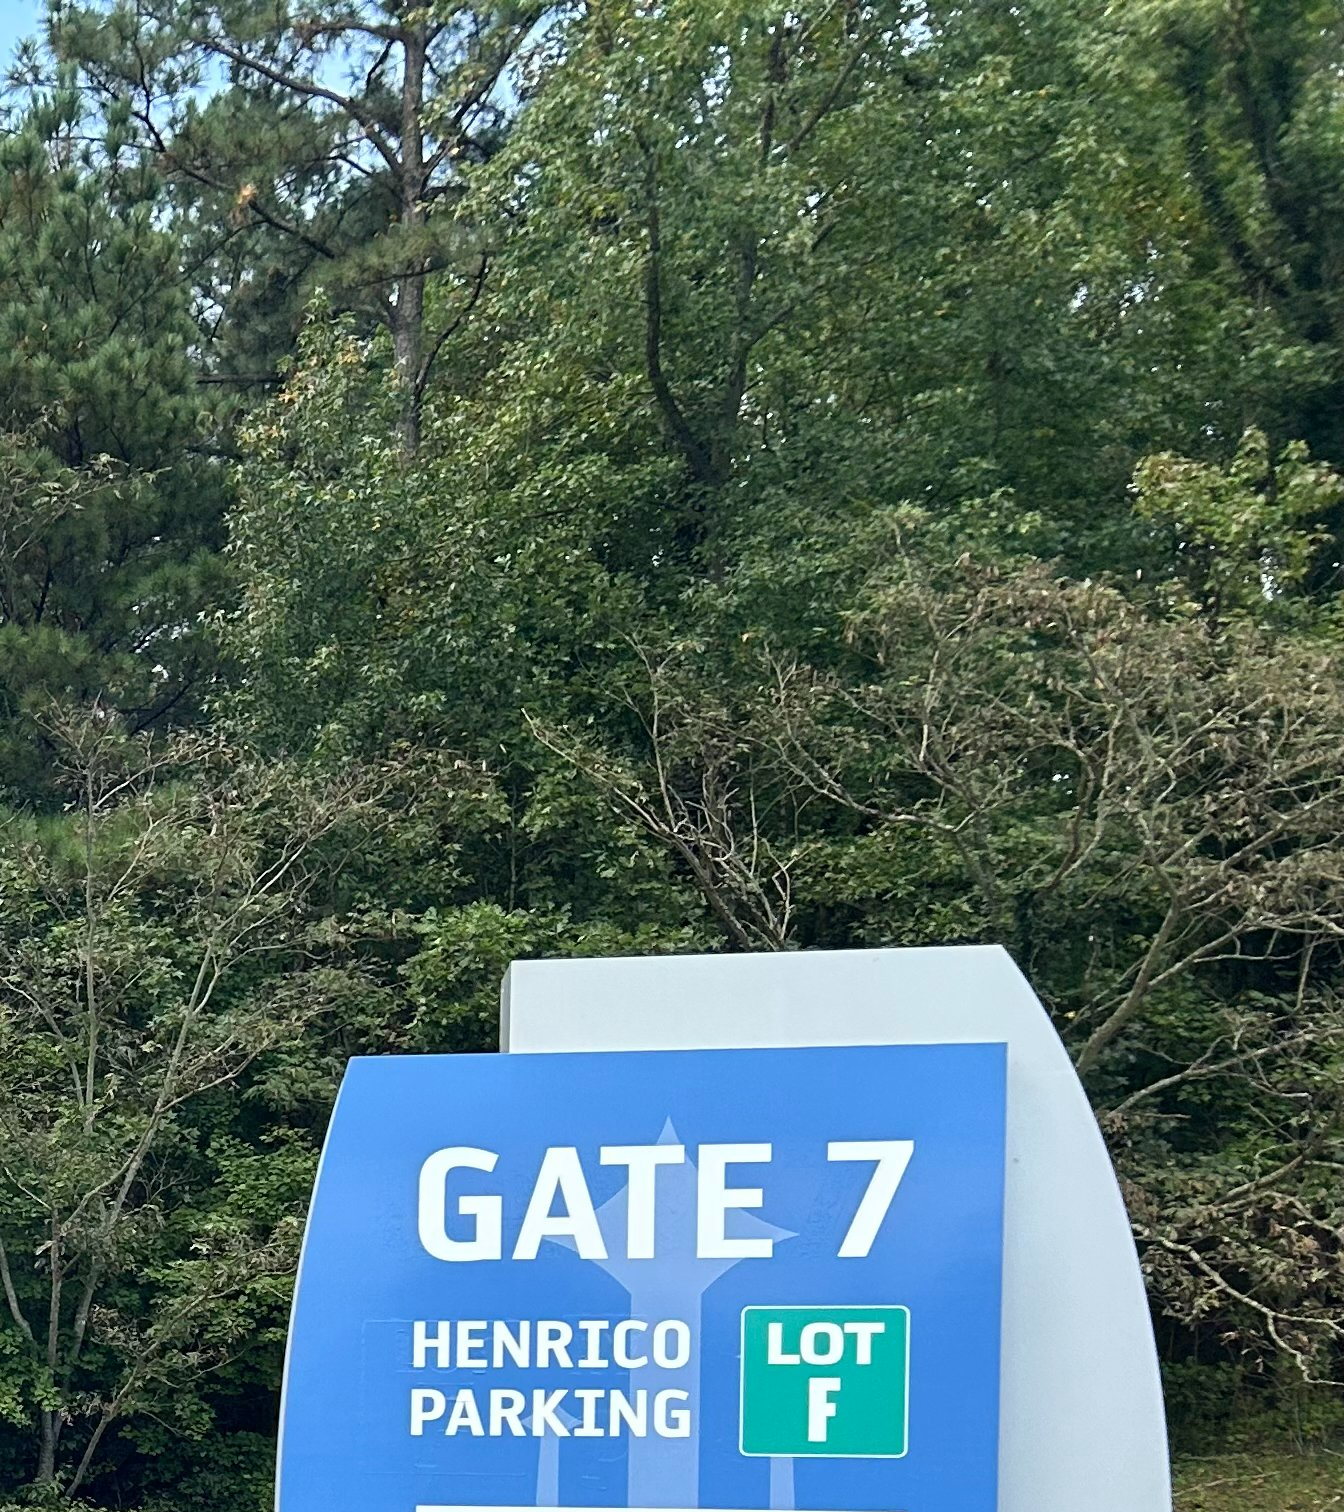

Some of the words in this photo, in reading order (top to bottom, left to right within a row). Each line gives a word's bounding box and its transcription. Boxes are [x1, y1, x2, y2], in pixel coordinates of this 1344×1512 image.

[417, 1143, 774, 1262] GATE
[826, 1139, 915, 1259] 7
[411, 1319, 692, 1370] HENRICO
[767, 1322, 885, 1365] LOT
[408, 1387, 692, 1438] PARKING
[807, 1376, 842, 1443] F
